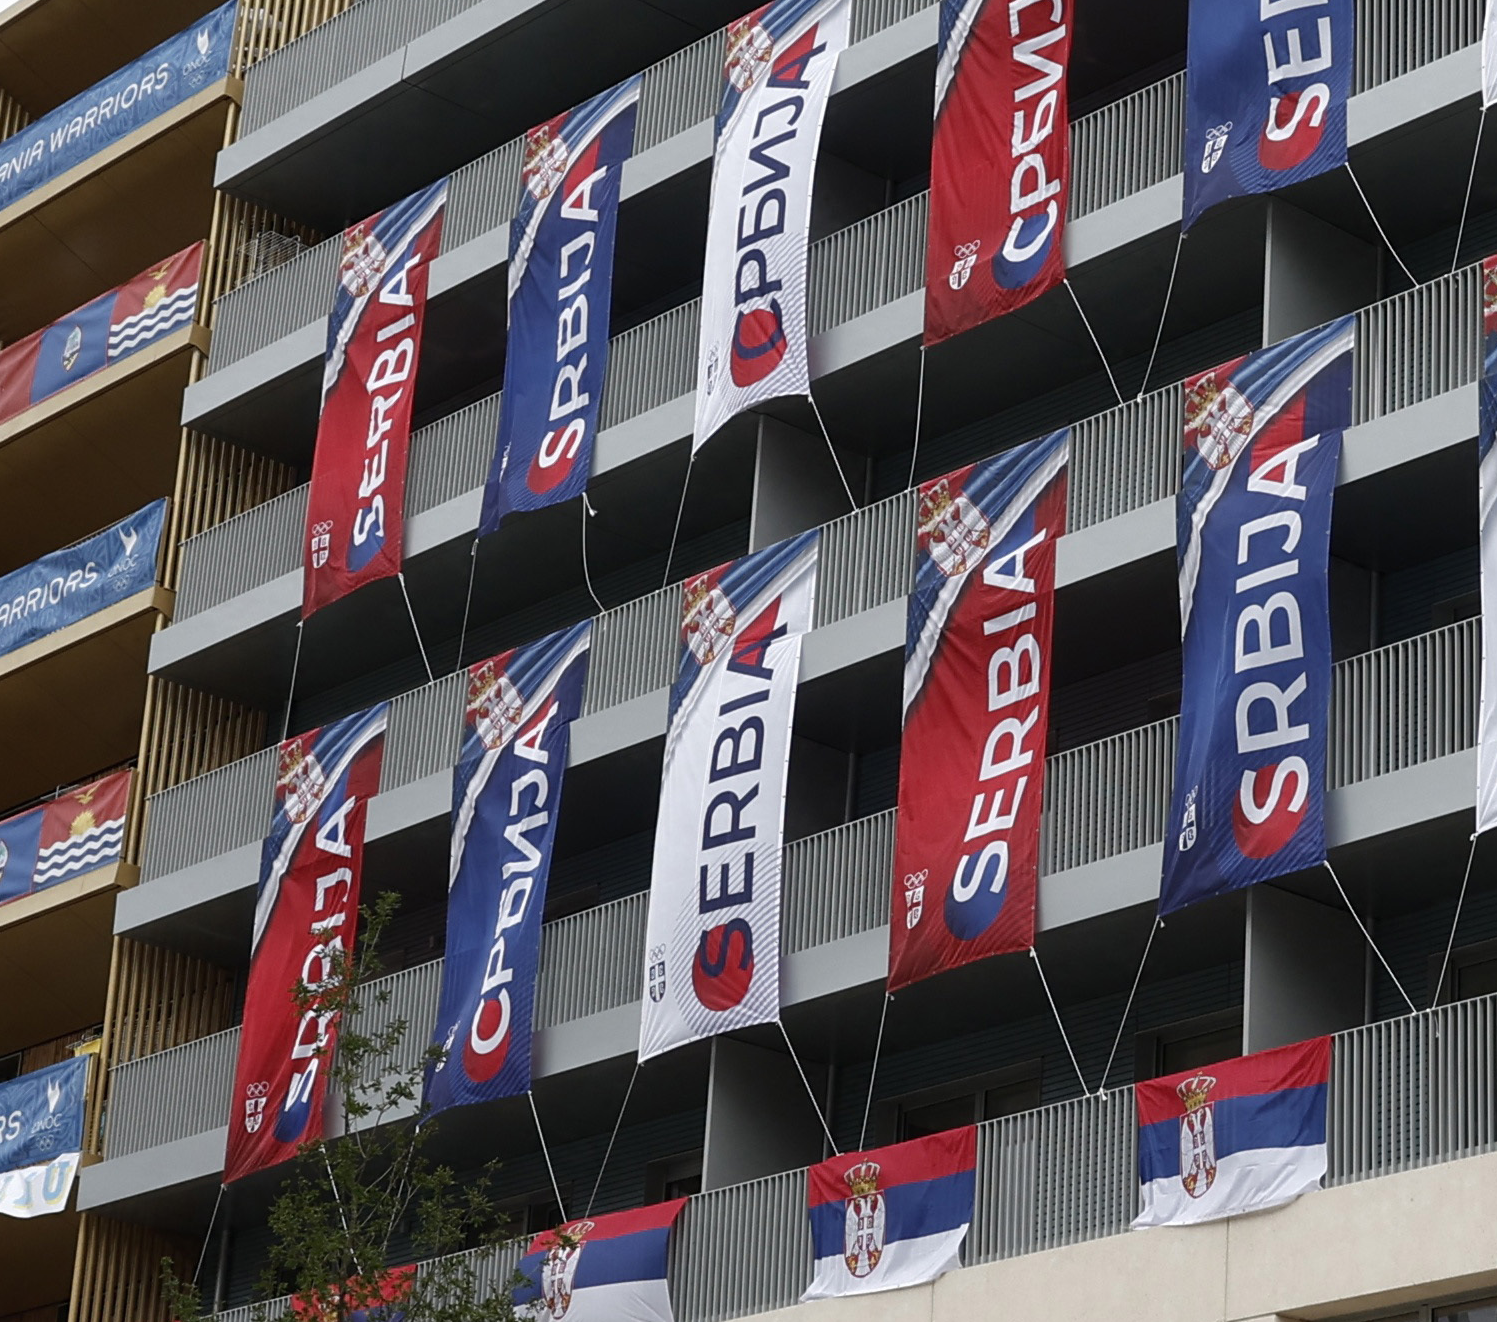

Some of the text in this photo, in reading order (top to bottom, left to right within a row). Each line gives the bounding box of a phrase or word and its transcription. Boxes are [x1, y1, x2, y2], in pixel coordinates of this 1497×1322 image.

[49, 63, 169, 150] WARRIORS
[733, 39, 827, 362] СРБИЈА
[352, 252, 421, 548] SERBIA
[537, 163, 607, 470] SRBIJA
[953, 527, 1046, 905] SERBIA
[1235, 433, 1320, 826] SRBIJA
[470, 700, 561, 1055] СРБИЈА
[698, 621, 788, 978] SERBIA
